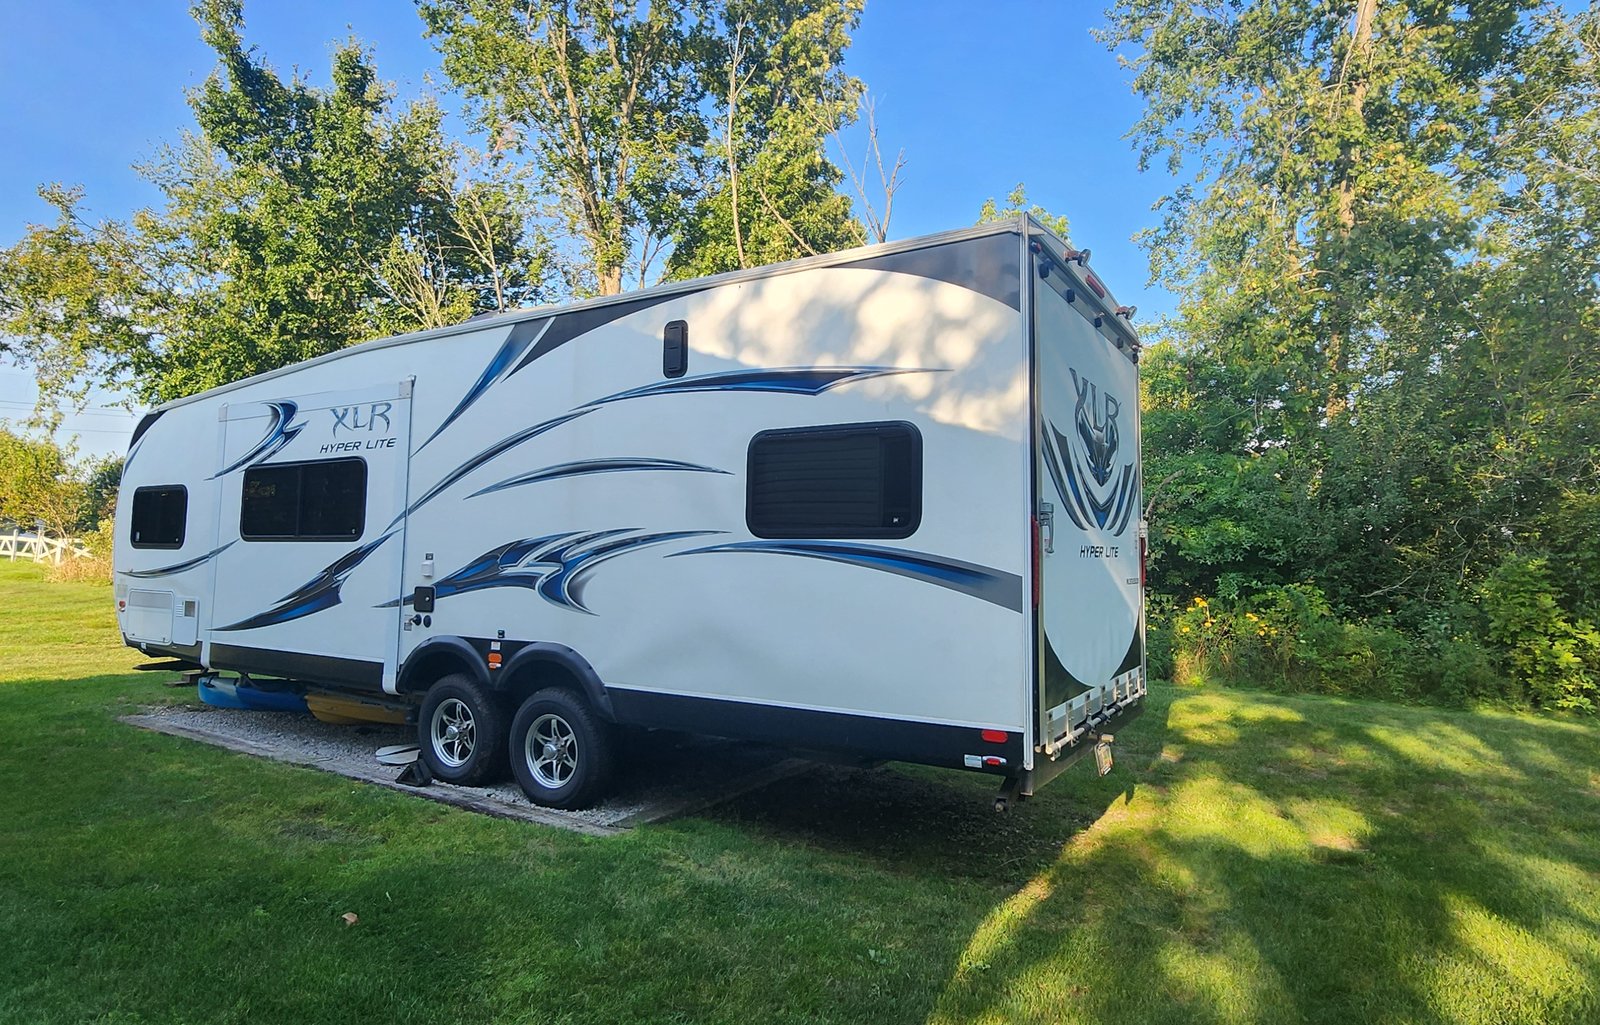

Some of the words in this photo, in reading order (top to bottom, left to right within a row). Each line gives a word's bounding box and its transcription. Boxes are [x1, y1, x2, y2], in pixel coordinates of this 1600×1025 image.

[1069, 367, 1121, 446] XLR
[330, 402, 392, 438] XLR
[320, 441, 362, 453] HYPER
[366, 438, 397, 449] LITE
[1080, 545, 1103, 558] HYPER
[1105, 546, 1119, 558] LITE
